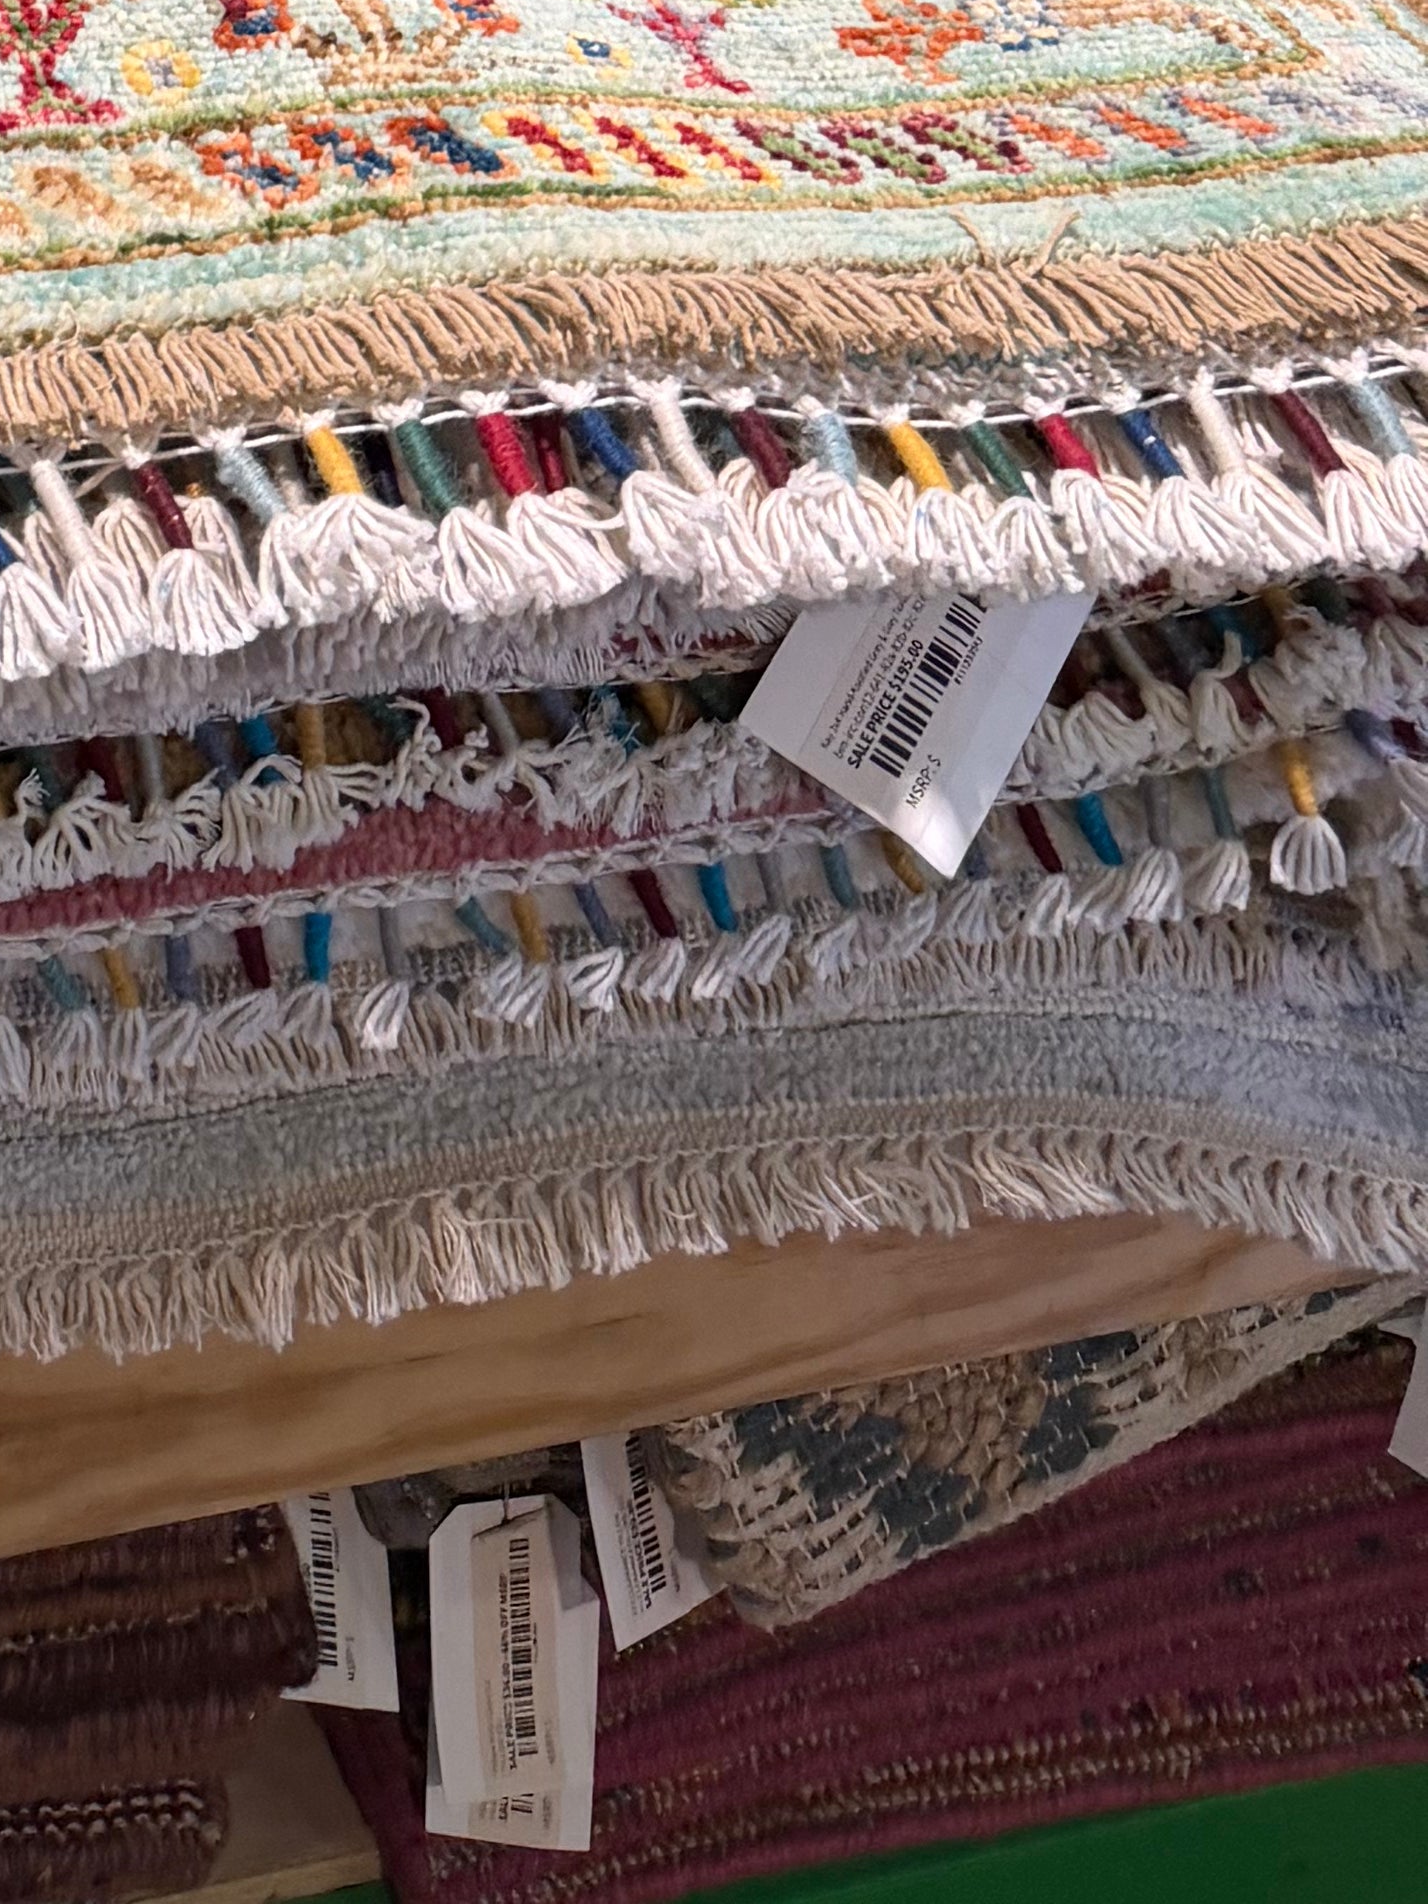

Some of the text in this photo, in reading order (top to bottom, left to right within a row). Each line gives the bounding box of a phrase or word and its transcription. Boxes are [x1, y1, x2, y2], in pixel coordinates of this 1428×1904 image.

[845, 730, 874, 769] SALE
[864, 690, 897, 733] PRICE
[886, 637, 925, 692] $195.00
[904, 763, 936, 809] MSRP:
